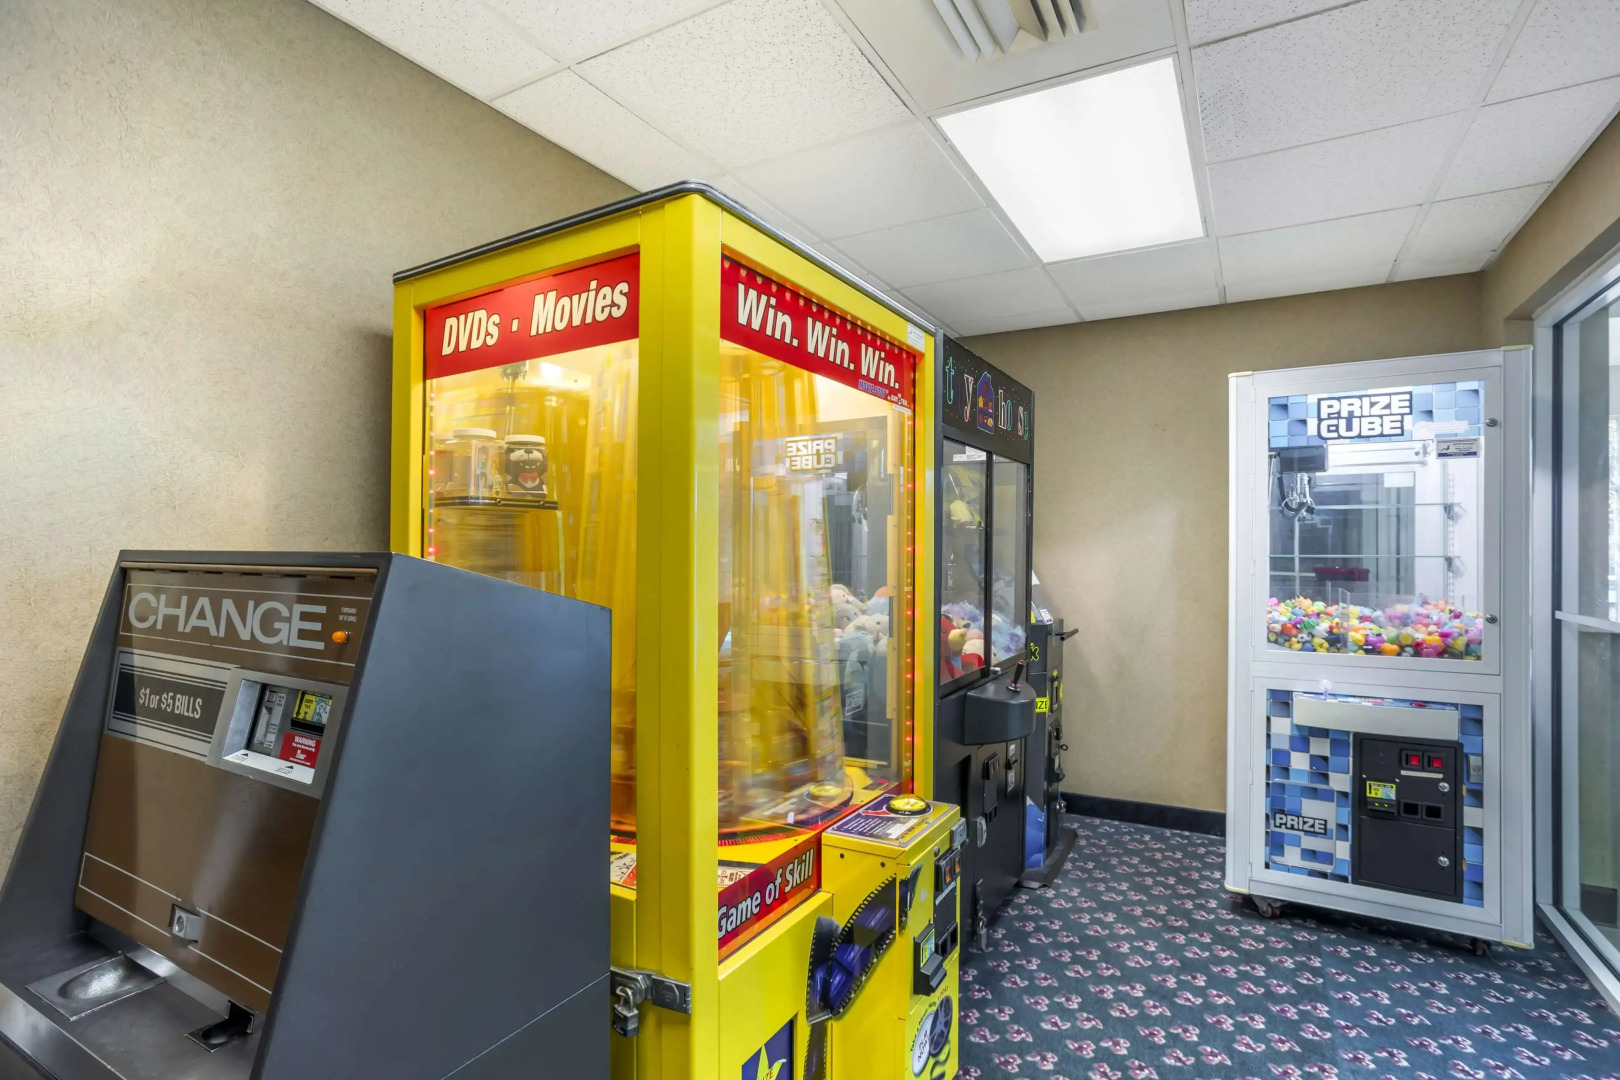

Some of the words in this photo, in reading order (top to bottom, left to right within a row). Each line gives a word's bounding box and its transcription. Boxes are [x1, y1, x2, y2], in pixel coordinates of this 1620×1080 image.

[442, 308, 500, 357] DVDs
[529, 279, 630, 337] Movies
[736, 281, 799, 348] Win.
[806, 313, 855, 373] Win.
[860, 341, 901, 390] Win.
[998, 390, 1029, 441] hose
[1319, 394, 1411, 420] PRIZE
[1319, 415, 1398, 439] CUBE
[129, 592, 327, 650] CHANGE
[138, 686, 151, 707] $1
[149, 694, 160, 709] or
[160, 690, 174, 713] $5
[174, 693, 203, 719] BILLS
[1275, 813, 1326, 834] PRIZE
[717, 890, 760, 940] Game
[764, 871, 783, 905] of
[783, 847, 814, 894] Skill
